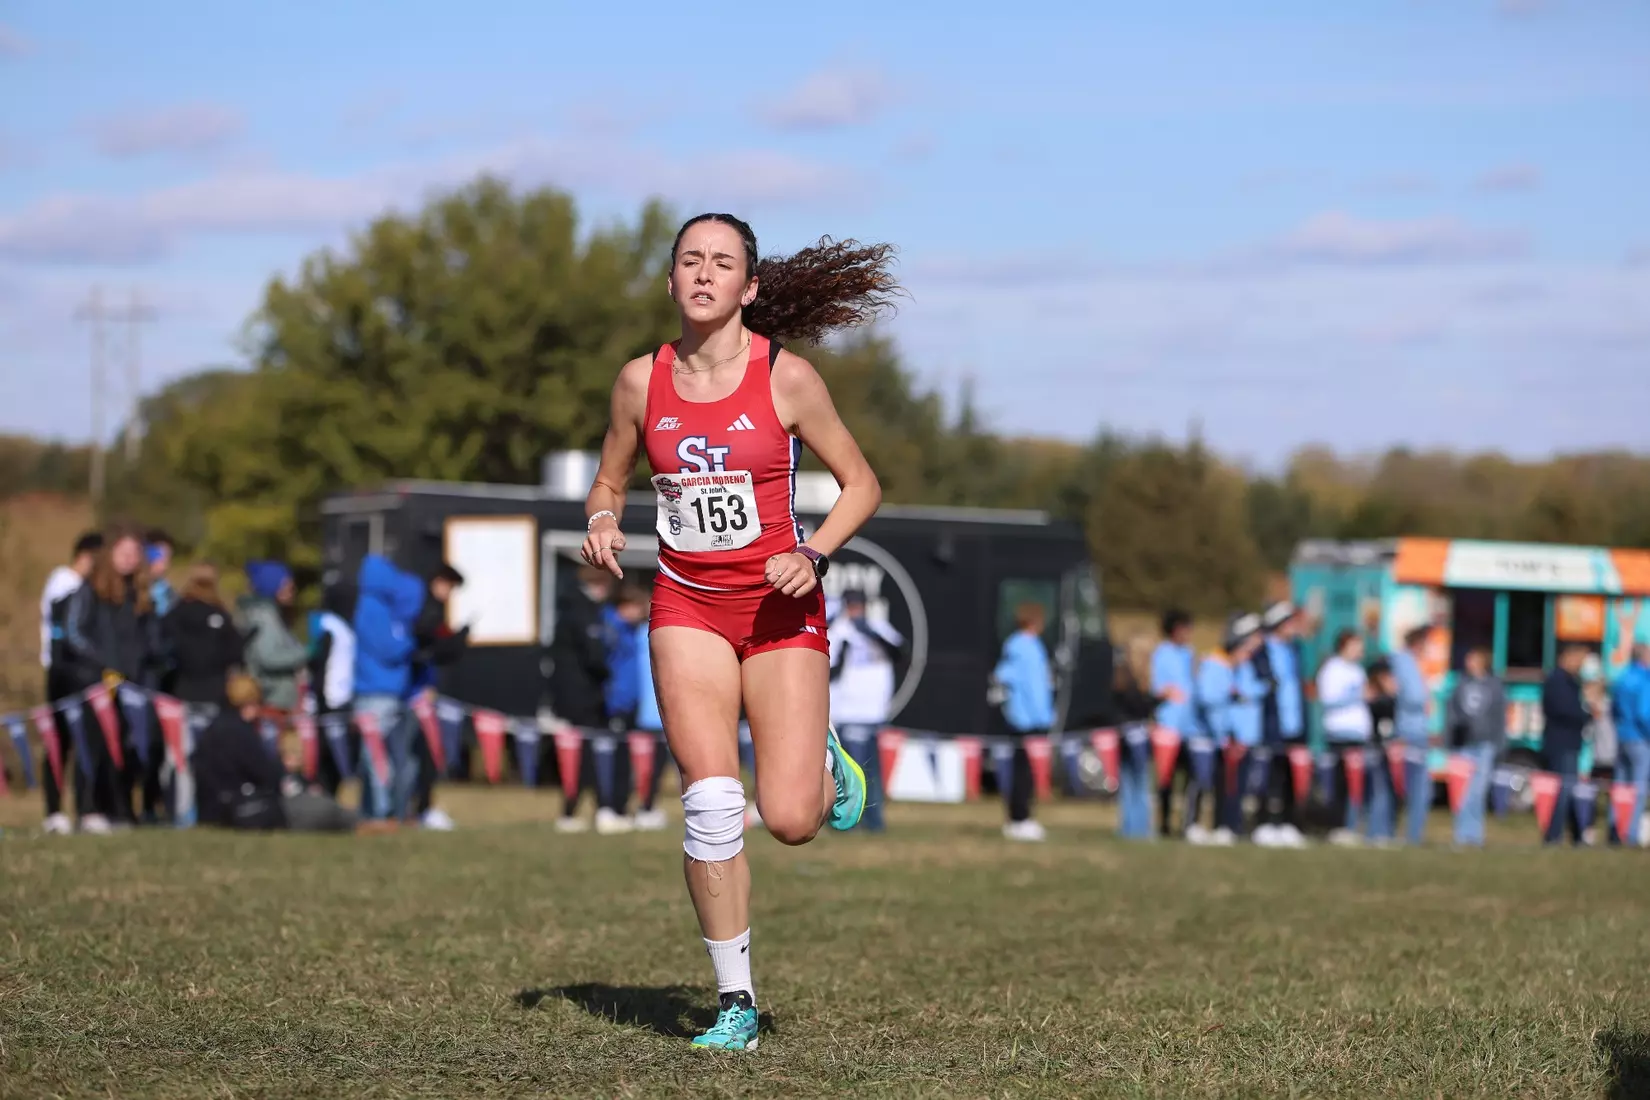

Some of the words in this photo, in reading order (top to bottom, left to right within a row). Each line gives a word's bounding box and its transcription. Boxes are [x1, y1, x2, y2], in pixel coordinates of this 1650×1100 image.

[681, 475, 710, 487] GARCIA
[712, 474, 746, 485] MORENO
[690, 494, 748, 533] 153
